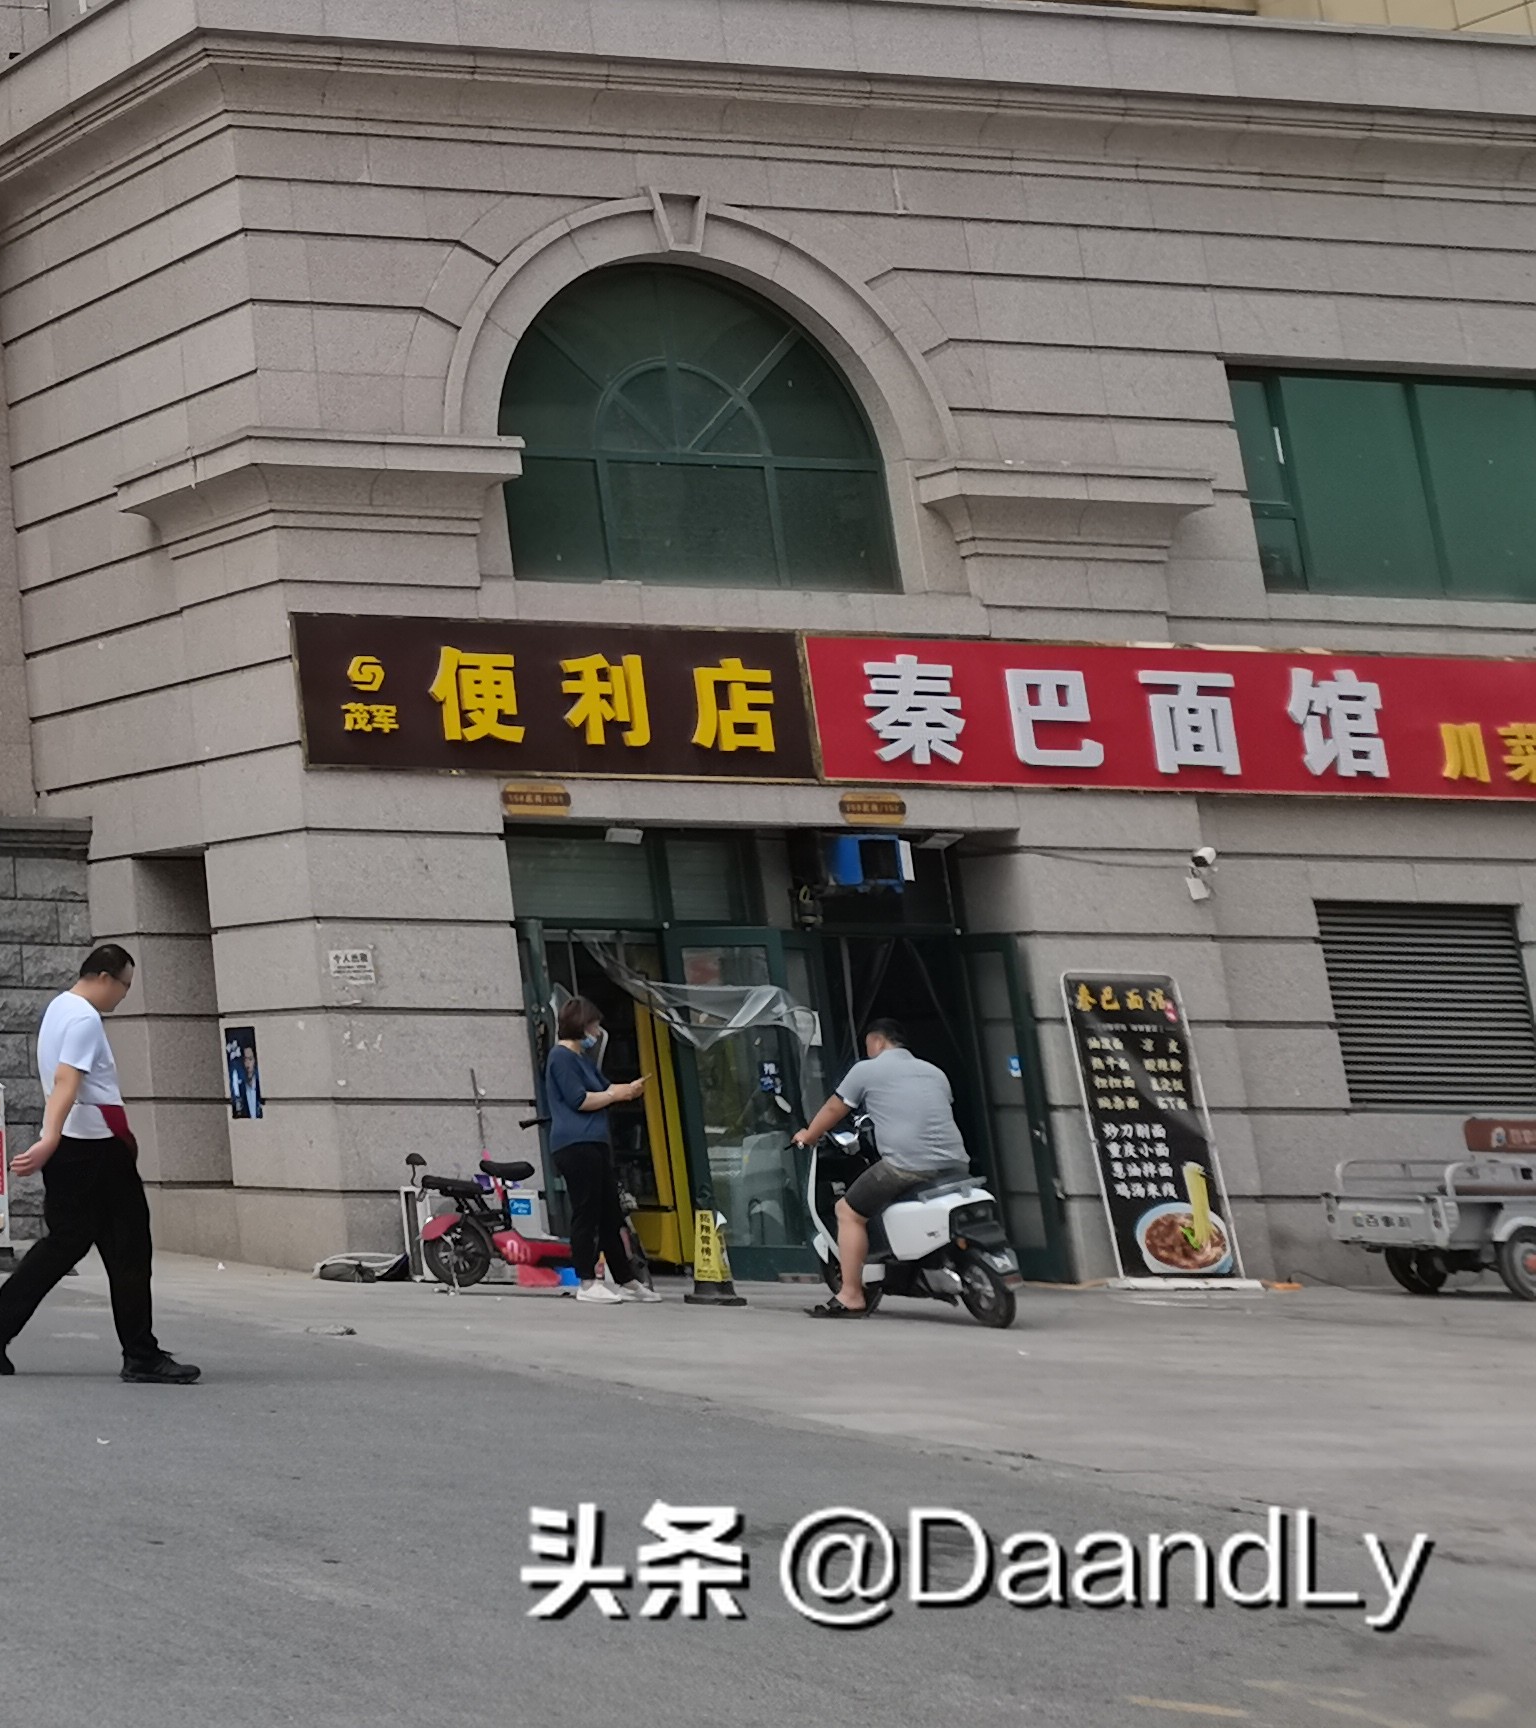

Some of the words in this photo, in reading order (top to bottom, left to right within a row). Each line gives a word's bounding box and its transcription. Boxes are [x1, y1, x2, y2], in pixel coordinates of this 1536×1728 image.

[341, 701, 400, 734] 茂军
[430, 645, 776, 753] 便利店
[863, 654, 1391, 778] 秦巴面馆
